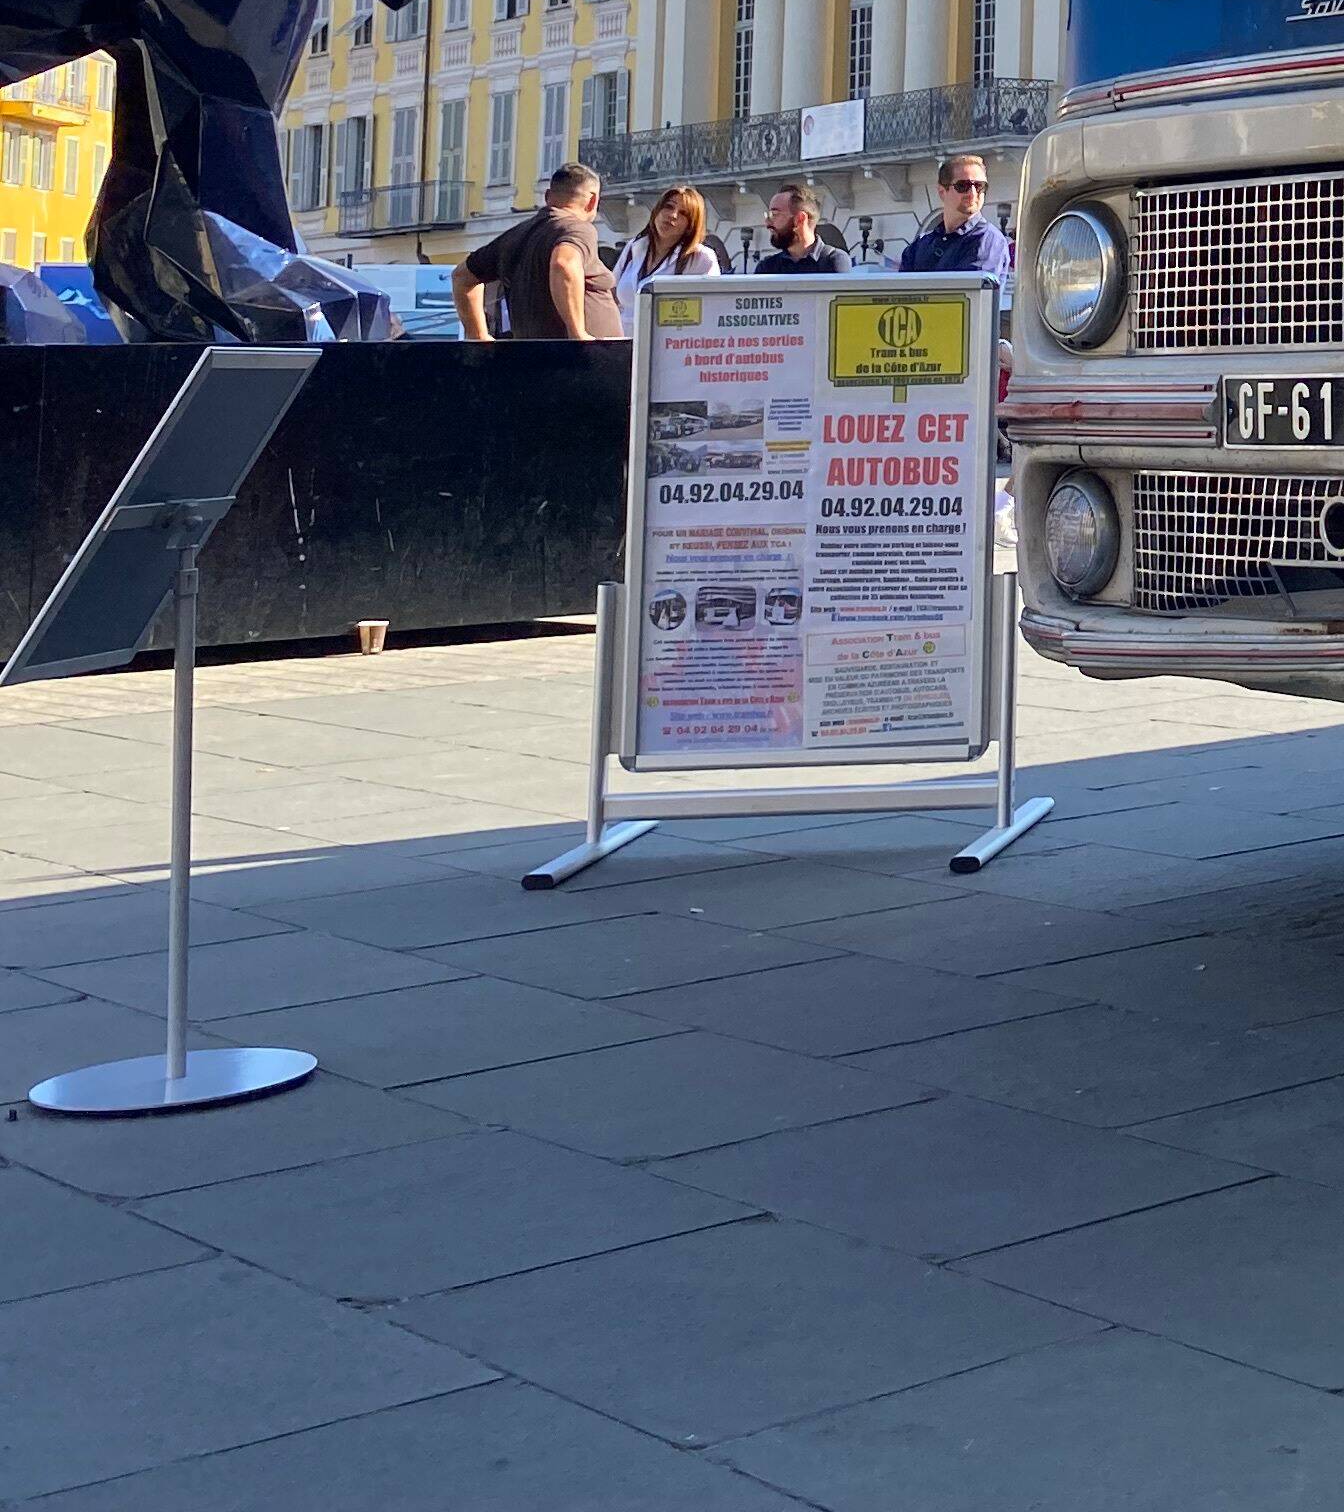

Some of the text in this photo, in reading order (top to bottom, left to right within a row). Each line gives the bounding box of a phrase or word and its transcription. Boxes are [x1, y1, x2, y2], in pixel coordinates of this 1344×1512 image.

[735, 297, 783, 310] SORTIES
[717, 313, 800, 328] ASSOCIATIVES
[880, 306, 919, 347] TCA
[665, 336, 725, 350] Participez
[738, 336, 760, 348] nos
[762, 334, 804, 348] sorties
[694, 353, 722, 366] bord
[725, 352, 784, 366] d'autobus
[870, 347, 897, 359] Tram
[909, 347, 928, 358] bus
[856, 361, 942, 374] de la Côte d'Azur
[700, 370, 769, 383] historiques
[823, 414, 906, 444] LOUEZ
[917, 413, 969, 443] CET
[827, 456, 960, 486] AUTOBUS
[659, 480, 804, 505] 04.92.04.29.04
[821, 496, 963, 517] 04.92.04.29.04
[815, 524, 840, 534] Nous
[842, 524, 866, 534] vous
[868, 524, 909, 536] prenons
[911, 524, 924, 533] en
[926, 523, 961, 535] charge
